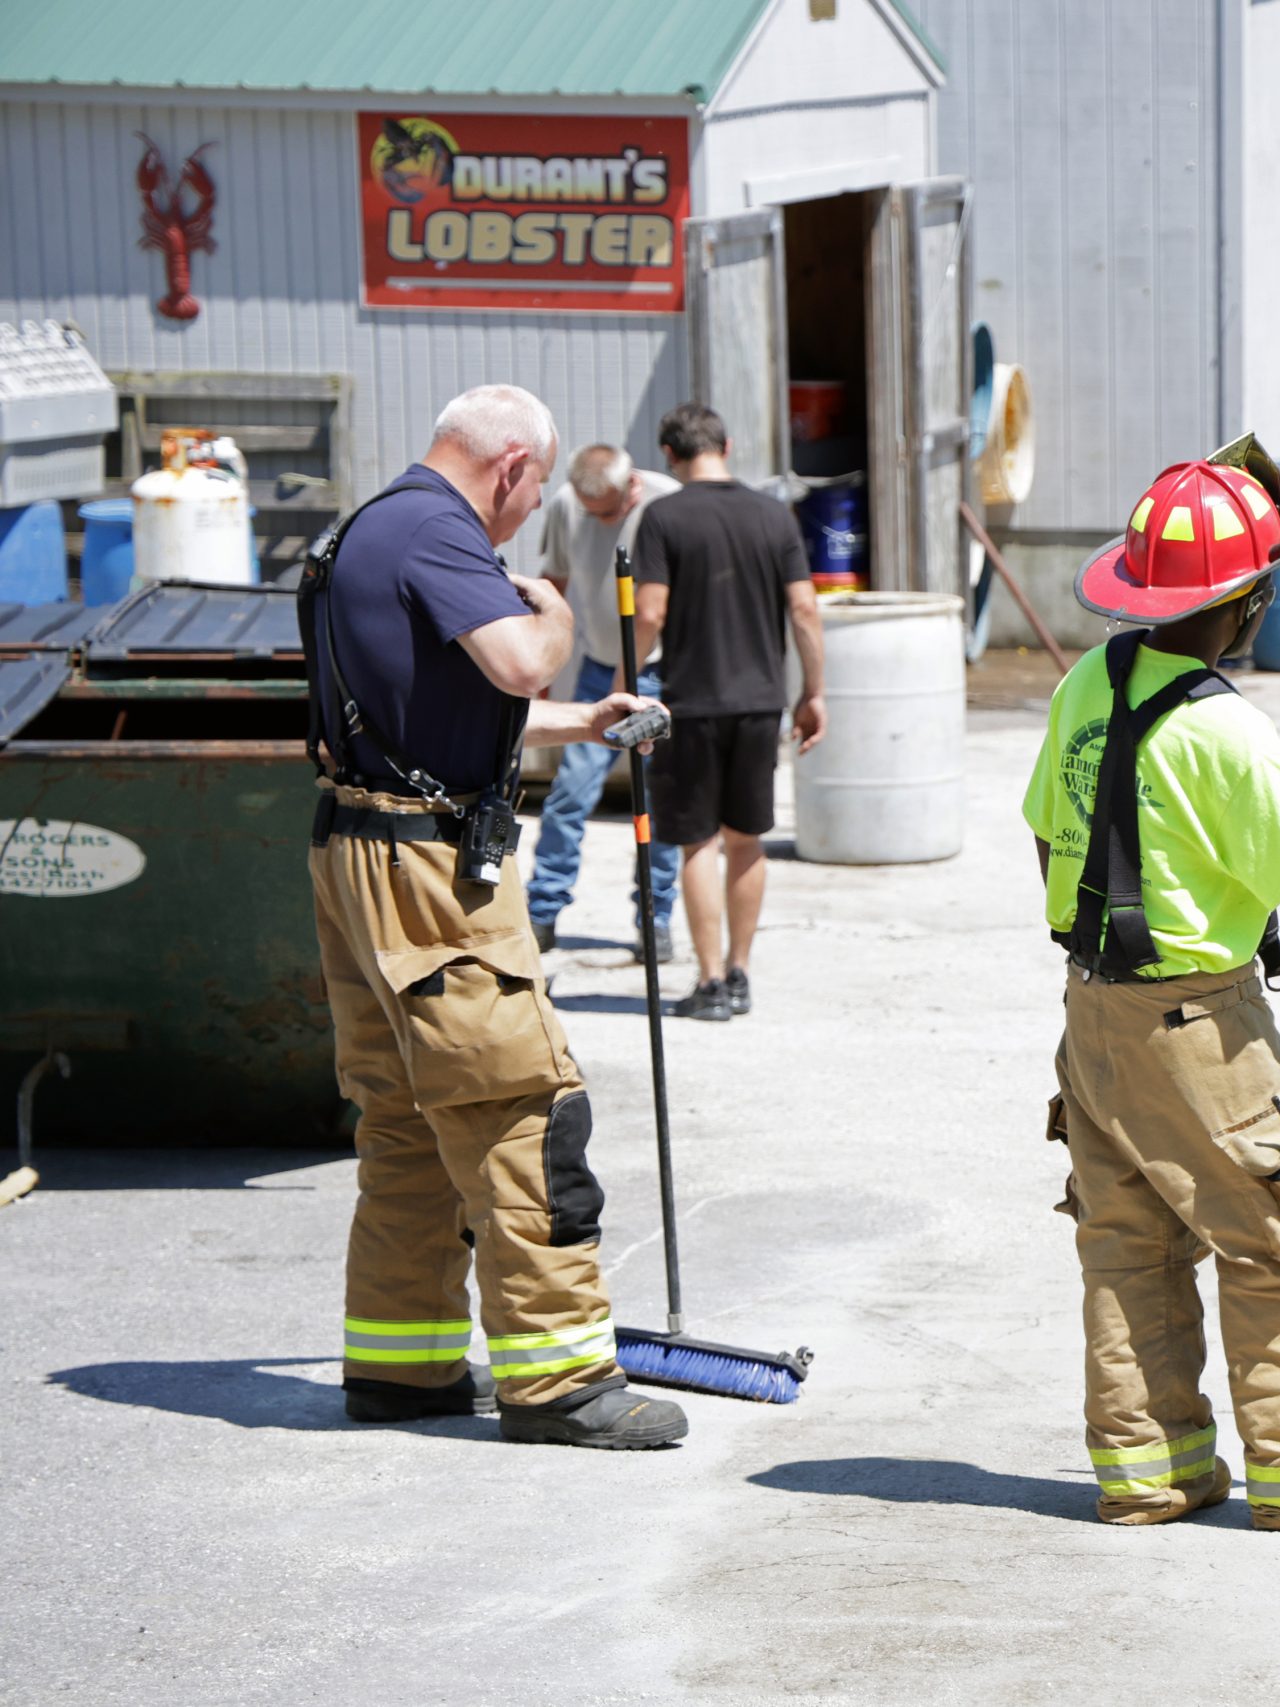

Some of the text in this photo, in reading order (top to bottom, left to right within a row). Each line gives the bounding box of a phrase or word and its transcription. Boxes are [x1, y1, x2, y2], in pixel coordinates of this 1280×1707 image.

[452, 148, 667, 202] DURANT'S
[388, 209, 672, 265] LOBSTER
[13, 832, 110, 847] ROGERS
[6, 857, 75, 868] SONS
